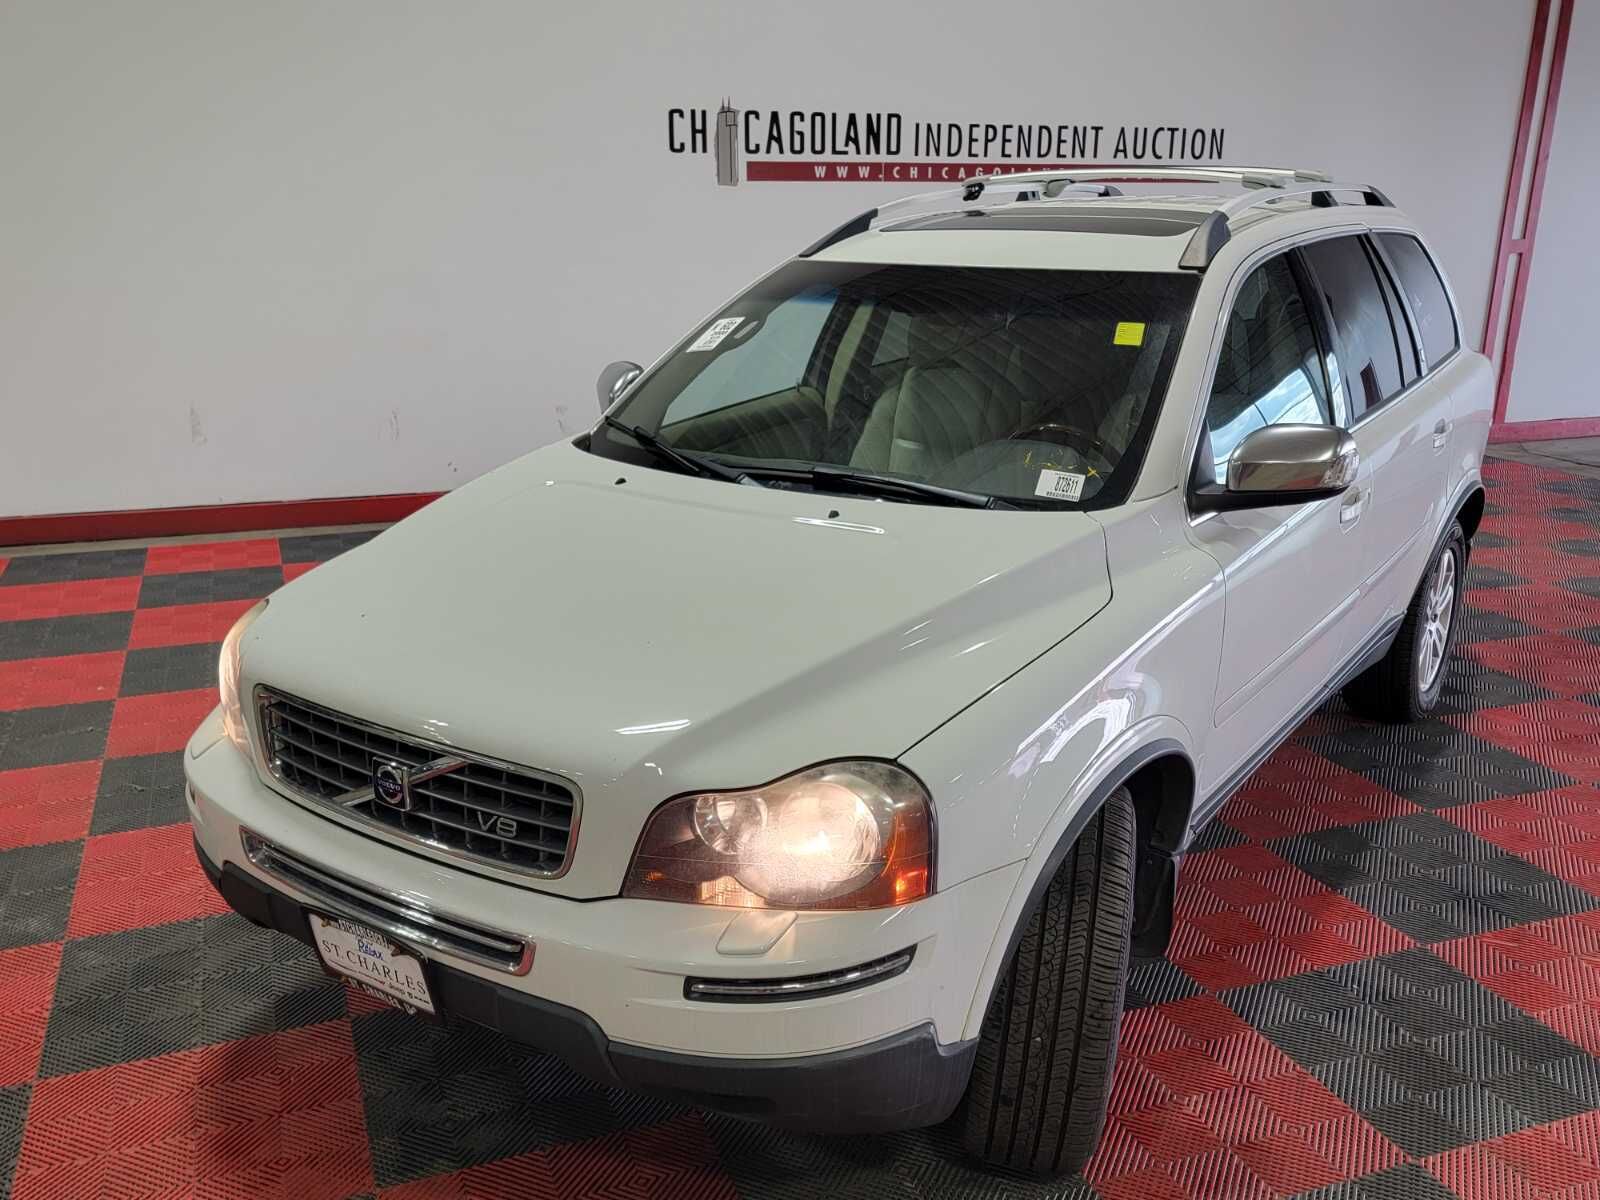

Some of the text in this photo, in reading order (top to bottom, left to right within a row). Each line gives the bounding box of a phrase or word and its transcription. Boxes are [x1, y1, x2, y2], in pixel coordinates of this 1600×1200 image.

[668, 108, 1226, 160] CHICAGOLAND INDEPENDENT AUCTION
[377, 778, 402, 792] VOLVO
[477, 811, 518, 839] V8
[346, 950, 428, 995] CHARLES
